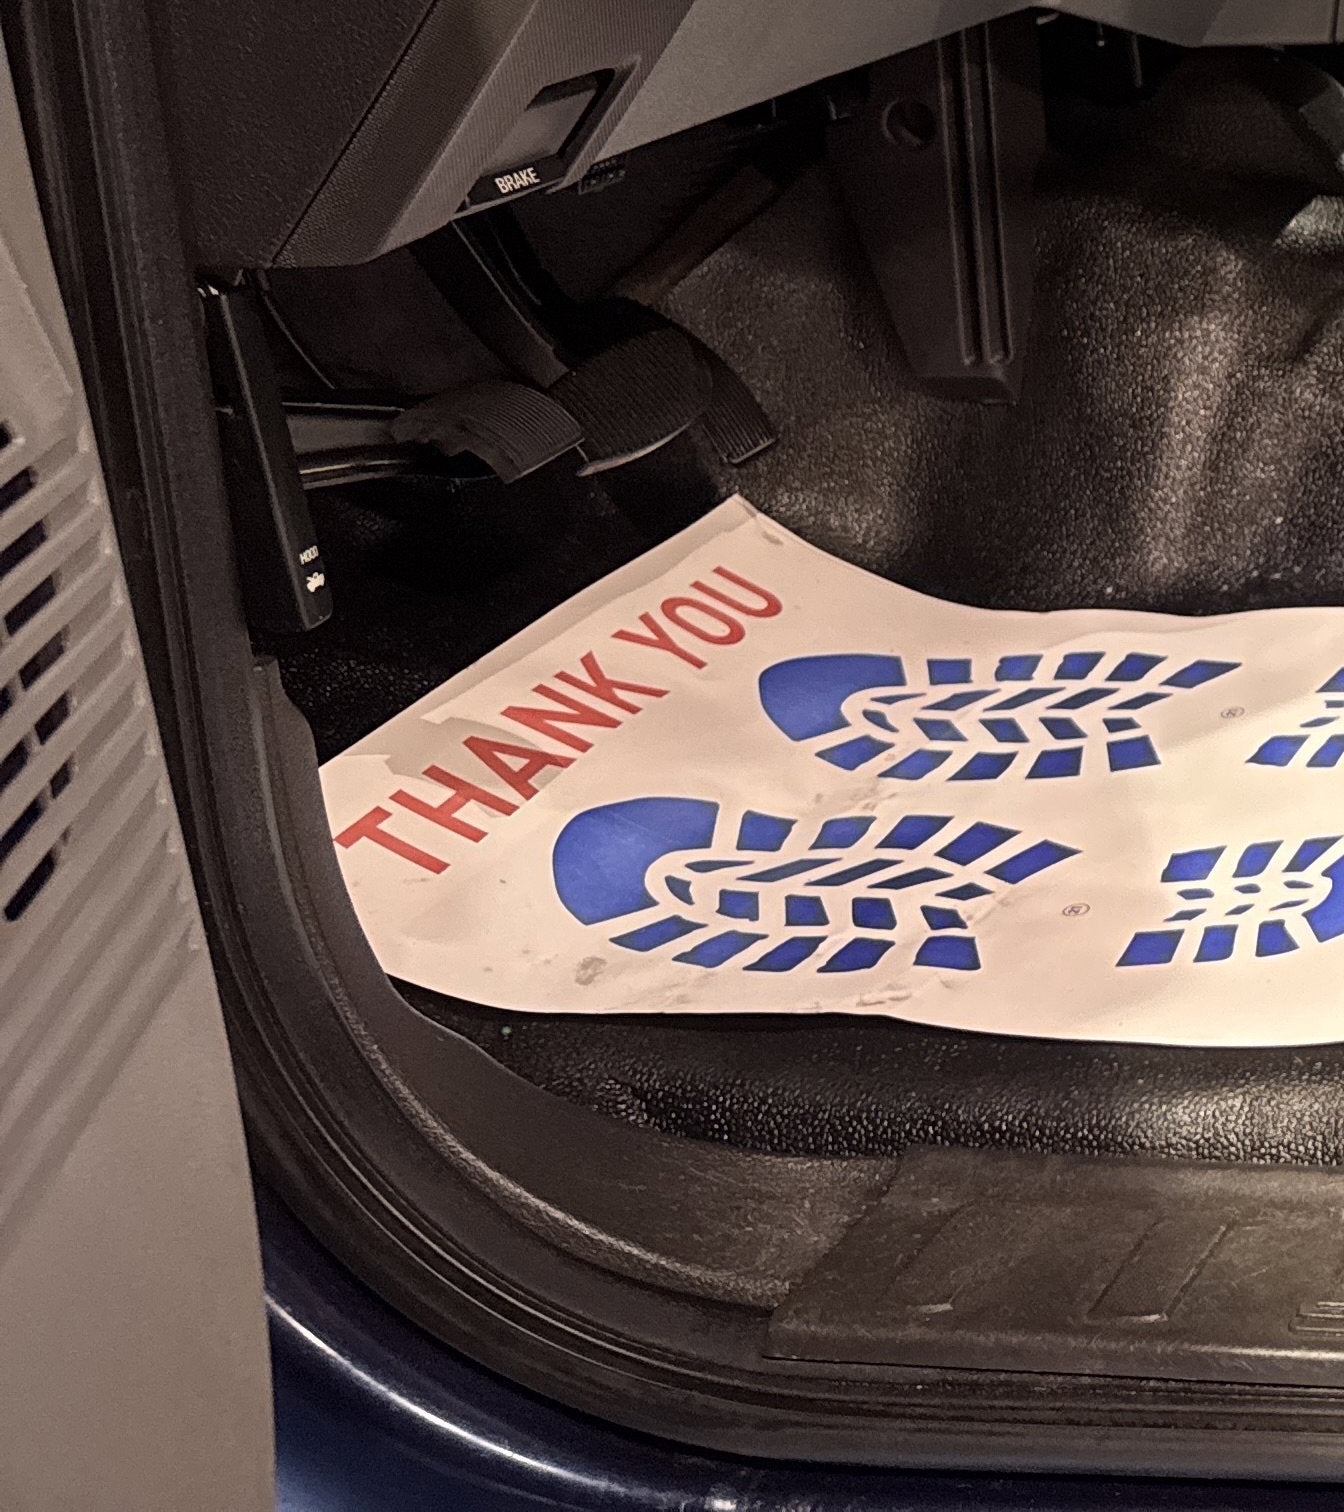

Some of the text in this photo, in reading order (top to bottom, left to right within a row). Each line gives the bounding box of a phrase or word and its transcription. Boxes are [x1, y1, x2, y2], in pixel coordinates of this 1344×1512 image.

[494, 167, 541, 194] BRAKE
[333, 566, 783, 875] THANK YOU
